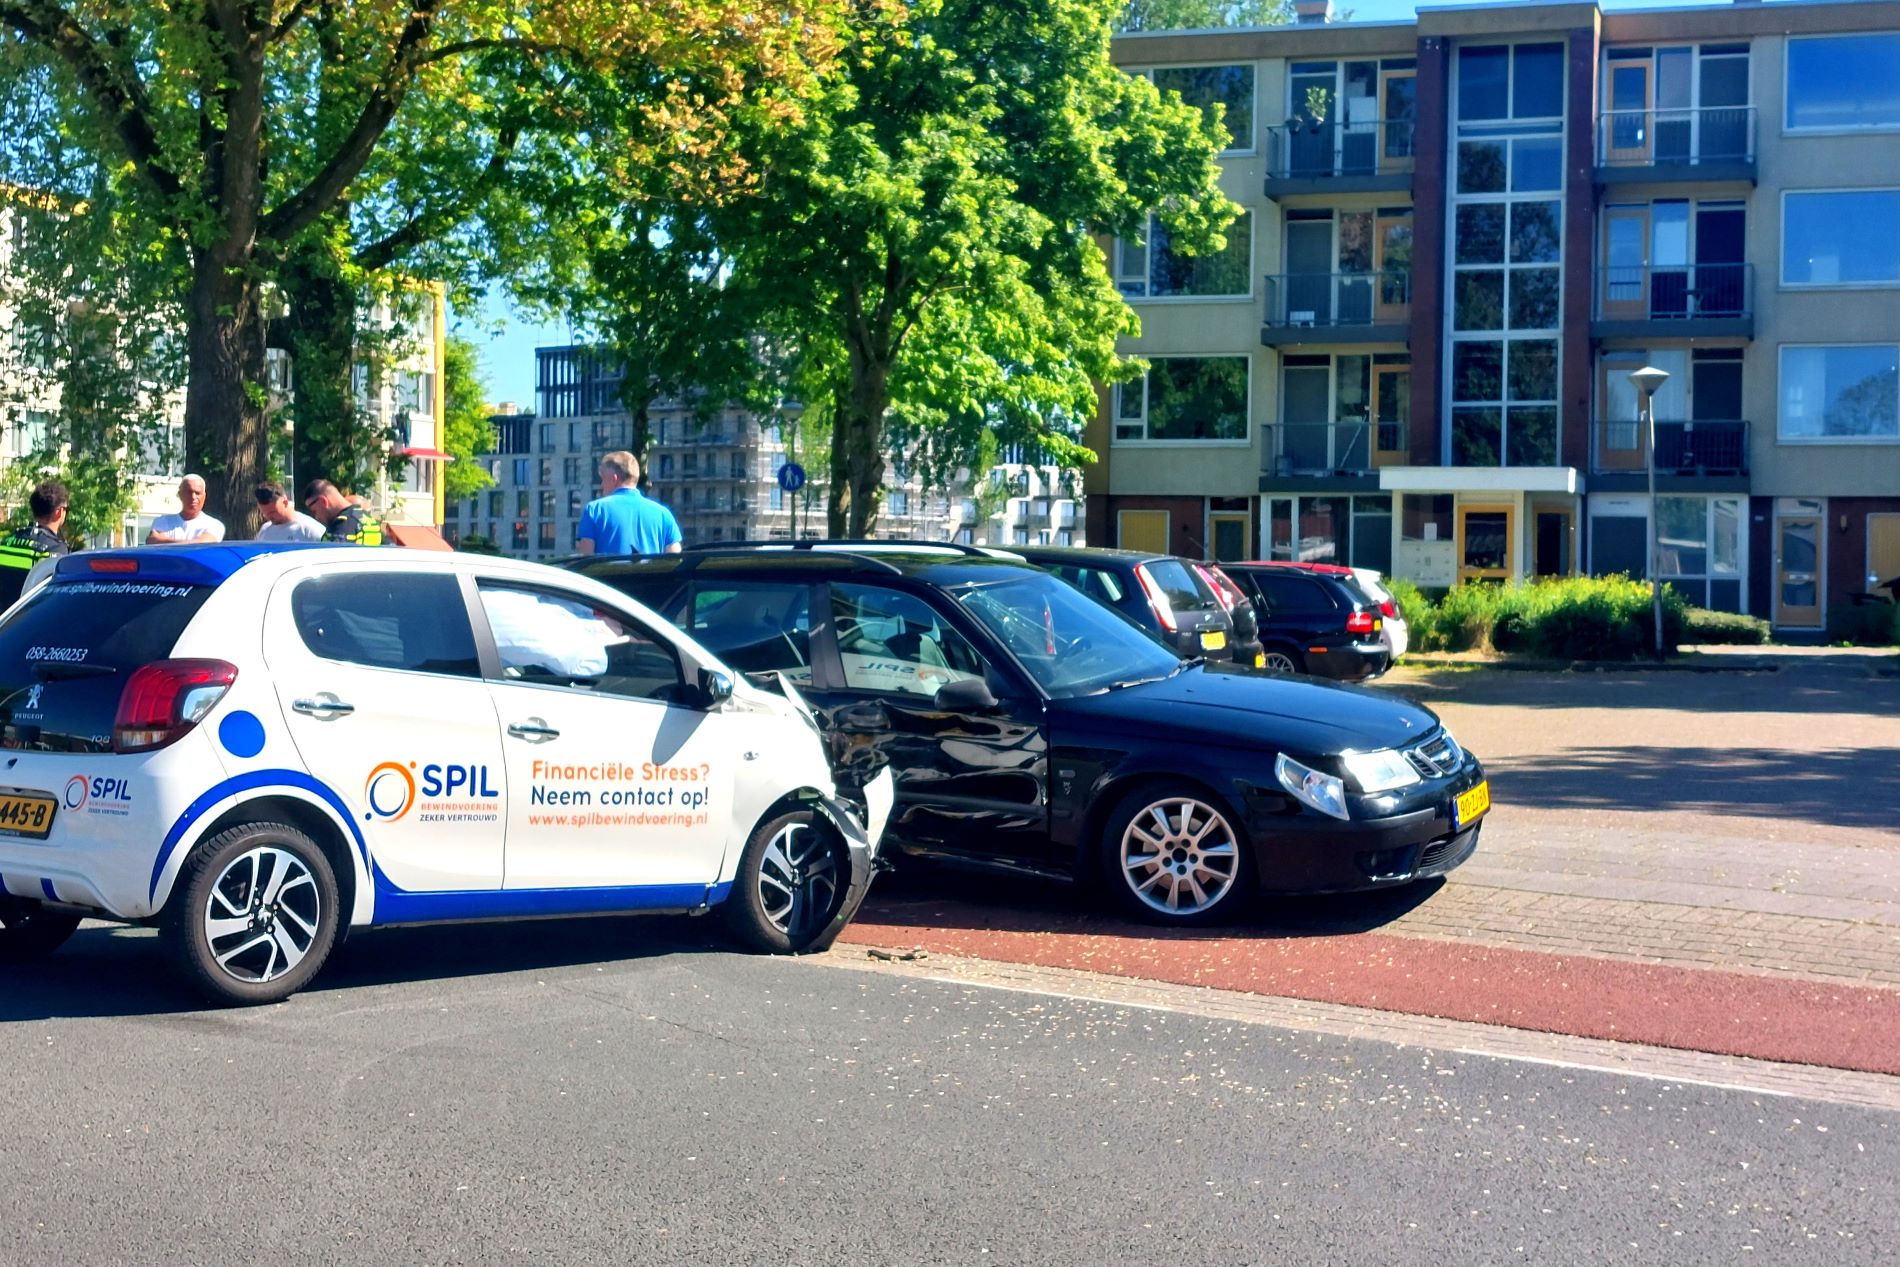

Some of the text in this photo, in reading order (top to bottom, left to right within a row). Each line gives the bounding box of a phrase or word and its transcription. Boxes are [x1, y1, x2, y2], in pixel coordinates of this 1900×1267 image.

[25, 646, 88, 661] 058-2660253
[532, 760, 710, 781] Financiële Stress?
[91, 777, 132, 800] SPIL
[421, 764, 499, 797] SPIL
[531, 785, 709, 810] Neem contact op!
[421, 803, 498, 811] BEWINDVOERING
[420, 814, 498, 822] ZEKER VERTROUWD
[529, 812, 708, 828] www.spilbewindvoering.nl
